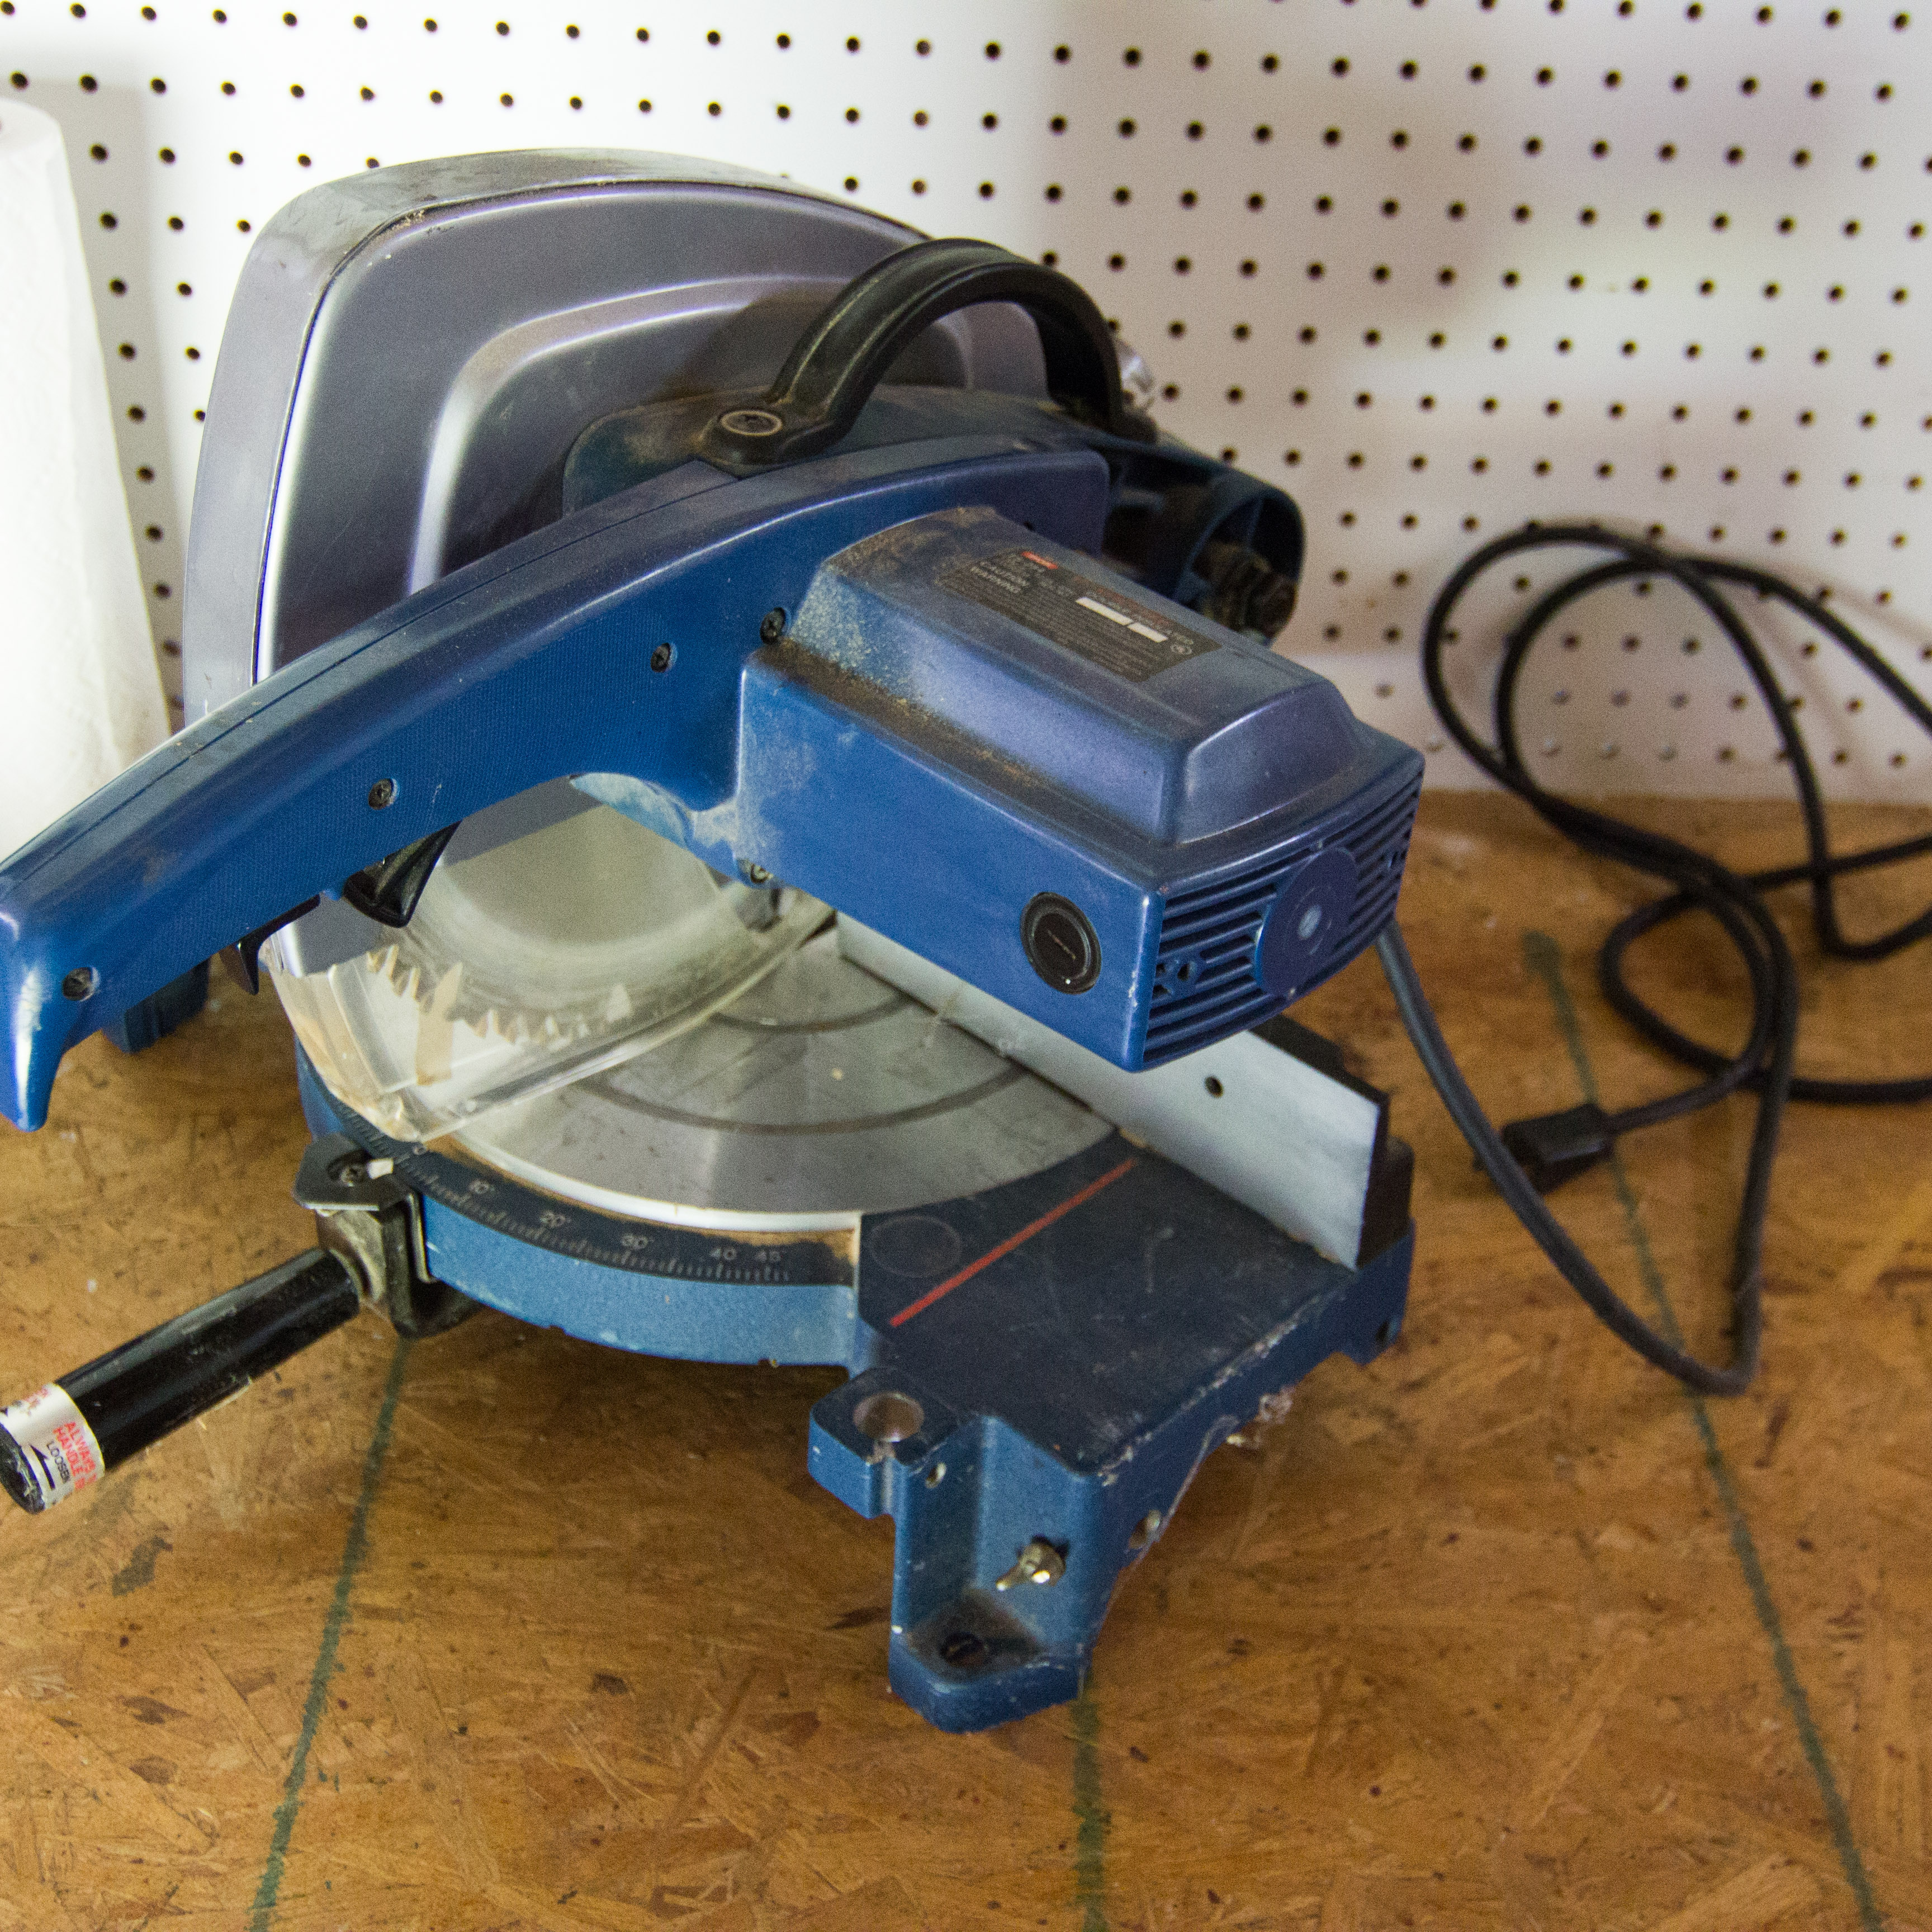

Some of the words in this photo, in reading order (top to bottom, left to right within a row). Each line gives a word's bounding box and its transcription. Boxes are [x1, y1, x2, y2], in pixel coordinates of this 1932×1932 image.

[46, 1440, 72, 1484] LOOSEN
[53, 1426, 84, 1477] HANDLE
[64, 1422, 96, 1474] ALWAYS
